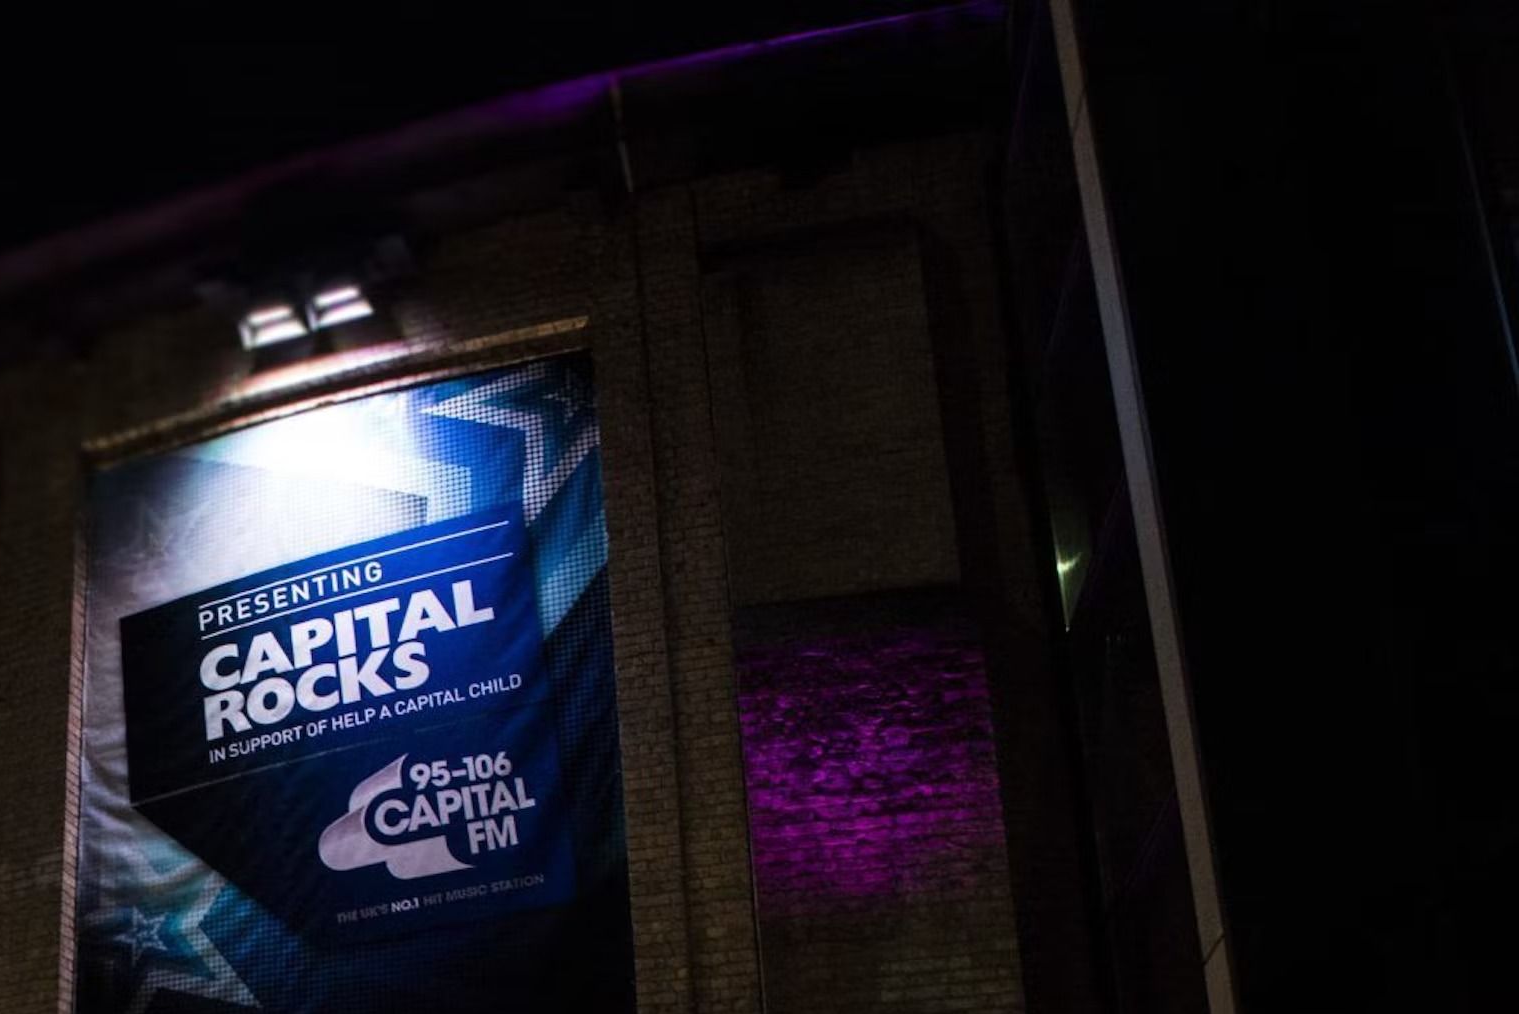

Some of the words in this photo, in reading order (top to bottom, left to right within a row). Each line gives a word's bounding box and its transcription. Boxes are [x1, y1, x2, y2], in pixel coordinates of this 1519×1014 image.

[198, 562, 382, 631] PRESENTING
[199, 580, 495, 691] CAPITAL
[204, 641, 430, 741] ROCKS
[209, 748, 226, 763] IN
[230, 726, 303, 757] SUPPORT
[307, 720, 328, 737] OF
[332, 708, 376, 731] HELP
[379, 705, 392, 719] A
[394, 688, 466, 715] CAPITAL
[469, 674, 522, 698] CHILD
[409, 752, 512, 790] 95-106
[374, 777, 535, 836] CAPITAL
[467, 815, 518, 854] FM
[337, 910, 358, 924] THE
[391, 897, 419, 912] NO.1
[423, 893, 443, 907] HIT
[446, 884, 488, 902] MUSIC
[491, 873, 544, 893] STATION
